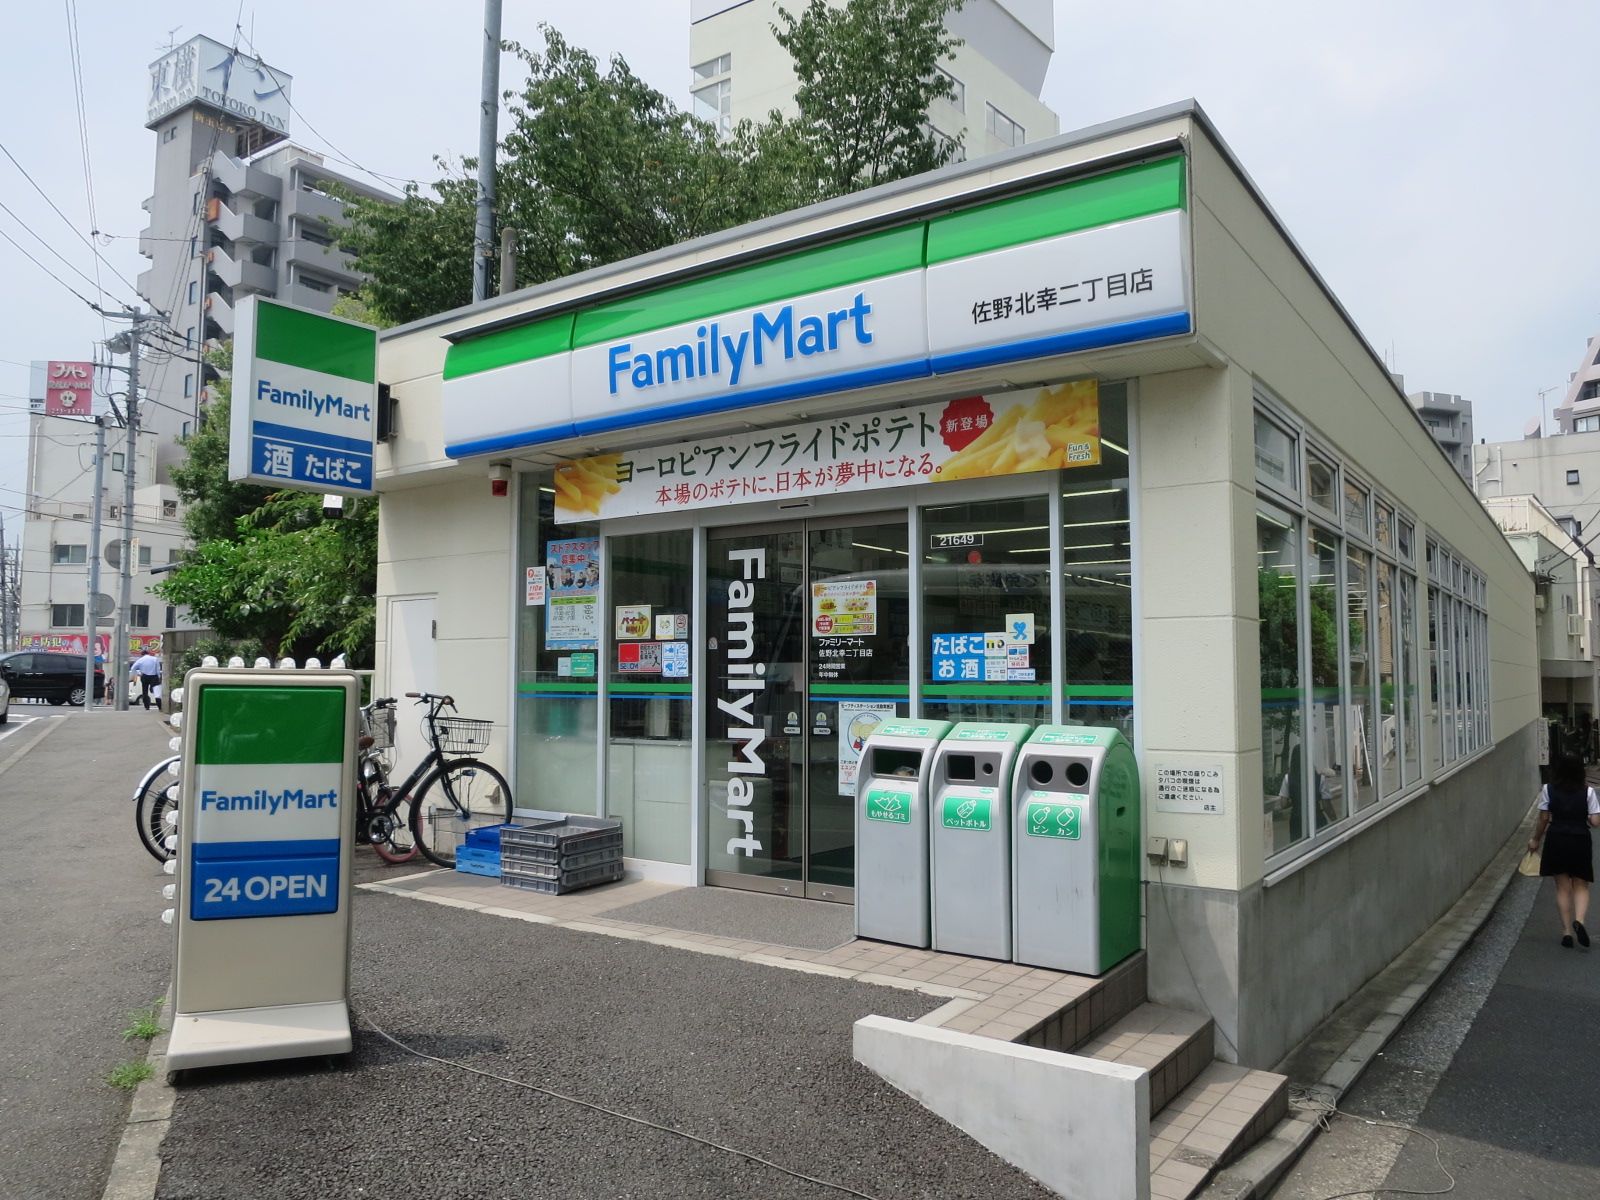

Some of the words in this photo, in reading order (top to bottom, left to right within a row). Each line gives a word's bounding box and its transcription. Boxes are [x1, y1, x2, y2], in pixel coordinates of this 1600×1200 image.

[202, 86, 257, 118] TOYOKO
[260, 110, 287, 129] INN
[971, 267, 1153, 325] 佐野北幸二丁目店
[608, 289, 873, 395] FamilyMart
[257, 379, 370, 422] FamilyMart
[945, 413, 988, 433] 新登場
[616, 411, 935, 484] ヨーロピアンフライドポテト
[1067, 443, 1083, 452] Fun
[1067, 451, 1091, 462] Fresh
[263, 442, 294, 477] 酒
[305, 453, 362, 484] たばこ
[656, 452, 943, 506] 本場のポテトに、日本が夢中になる。
[939, 534, 975, 546] 21649
[818, 638, 865, 647] ファミリーマート
[933, 636, 984, 655] たばこ
[818, 649, 873, 658] 佐野北幸二丁目店
[938, 658, 979, 679] お酒
[717, 547, 766, 857] FamilyMart
[201, 789, 337, 815] FamilyMart
[871, 809, 906, 821] もやせるゴミ
[946, 817, 987, 828] ペットボトル
[1056, 827, 1073, 836] カン
[204, 877, 241, 903] 24
[244, 874, 327, 901] OPEN
